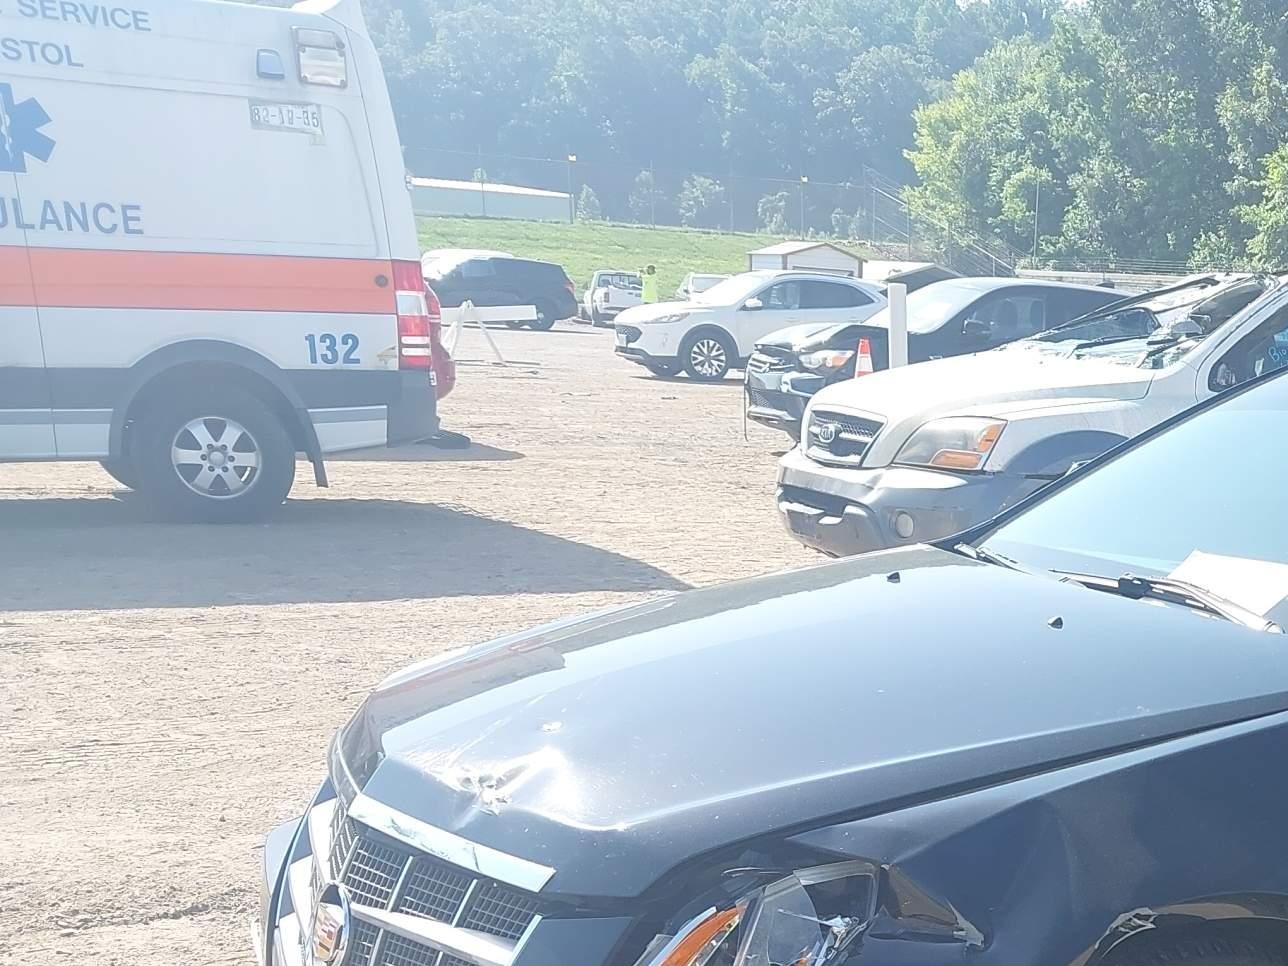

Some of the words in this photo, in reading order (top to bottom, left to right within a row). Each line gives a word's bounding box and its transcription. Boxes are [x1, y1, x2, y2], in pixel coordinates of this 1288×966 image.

[17, 0, 152, 32] SERVICE
[0, 37, 84, 68] STOL
[304, 333, 361, 365] 132
